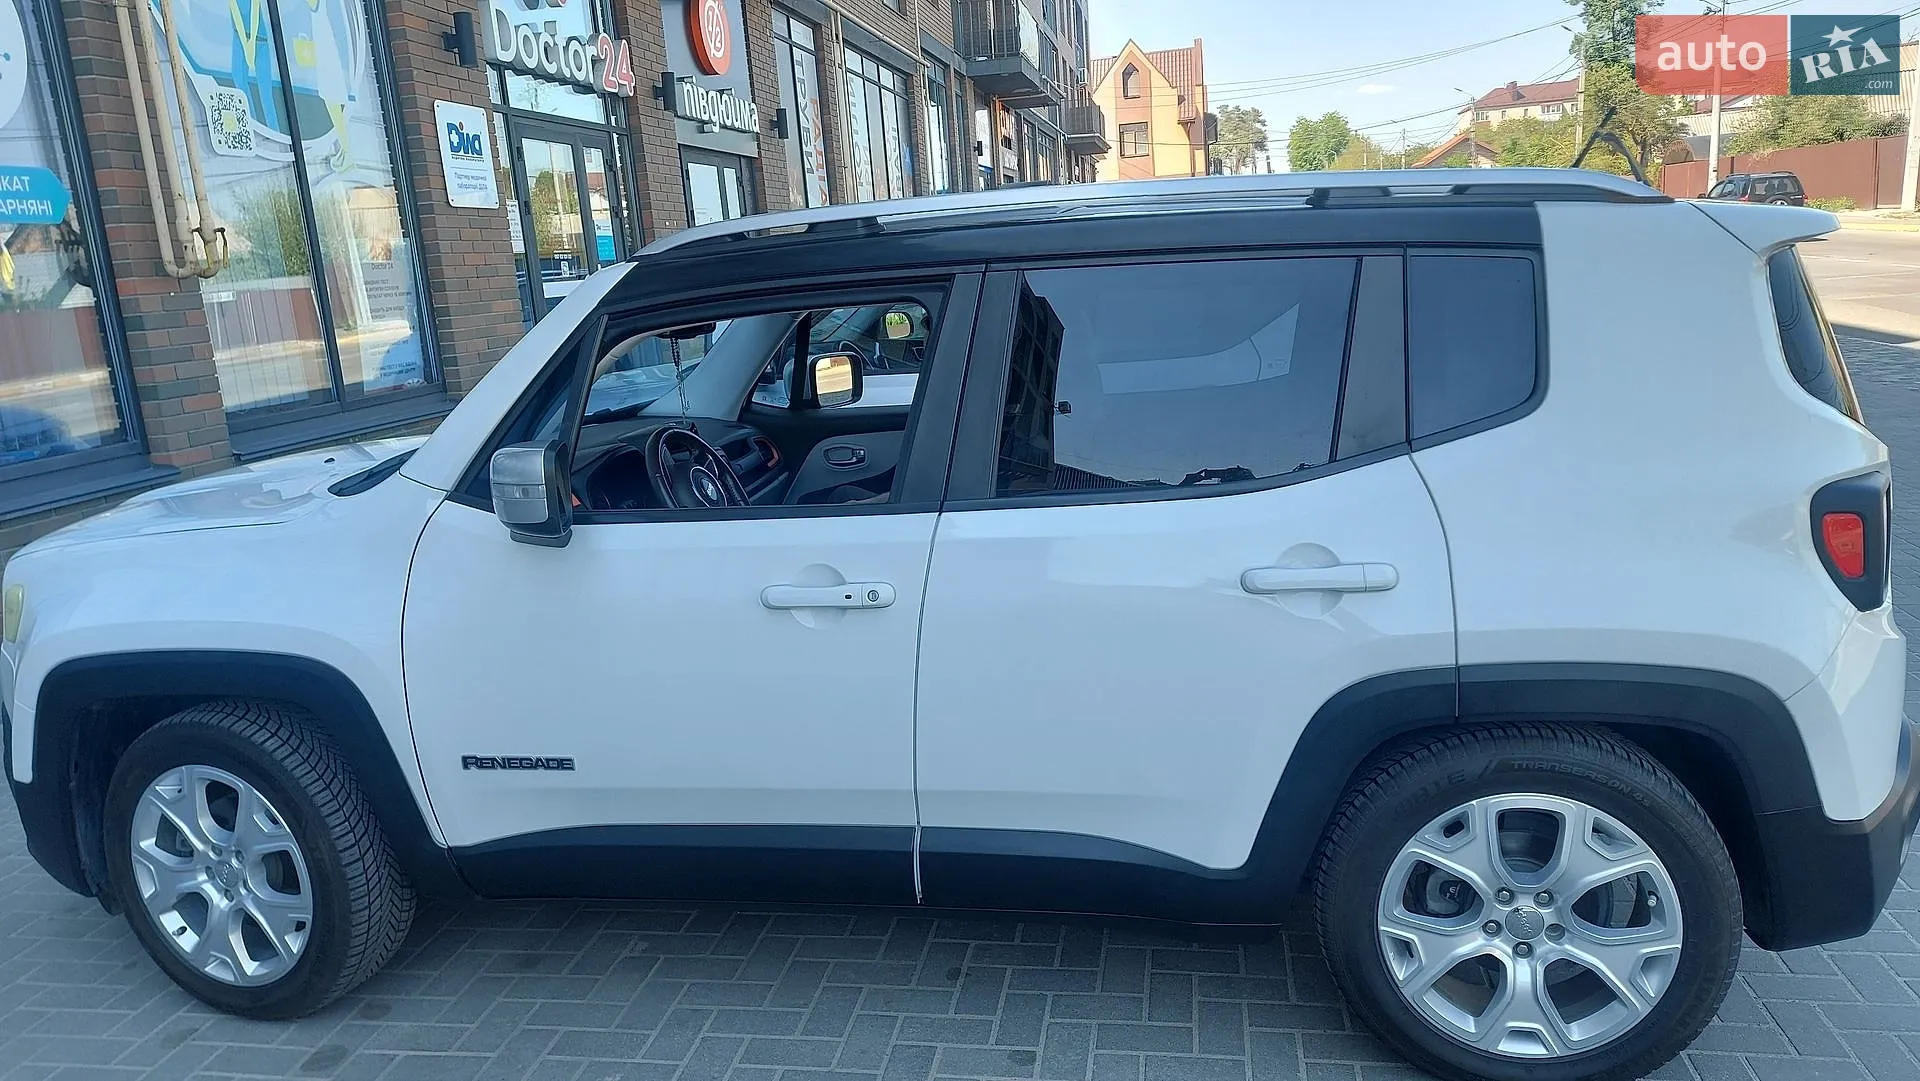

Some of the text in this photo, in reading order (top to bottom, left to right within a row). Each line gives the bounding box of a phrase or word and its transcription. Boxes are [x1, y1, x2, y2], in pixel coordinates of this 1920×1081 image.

[489, 1, 635, 97] Doctor 24
[795, 53, 815, 175] ТРУБИ
[462, 756, 575, 771] RENEGADE
